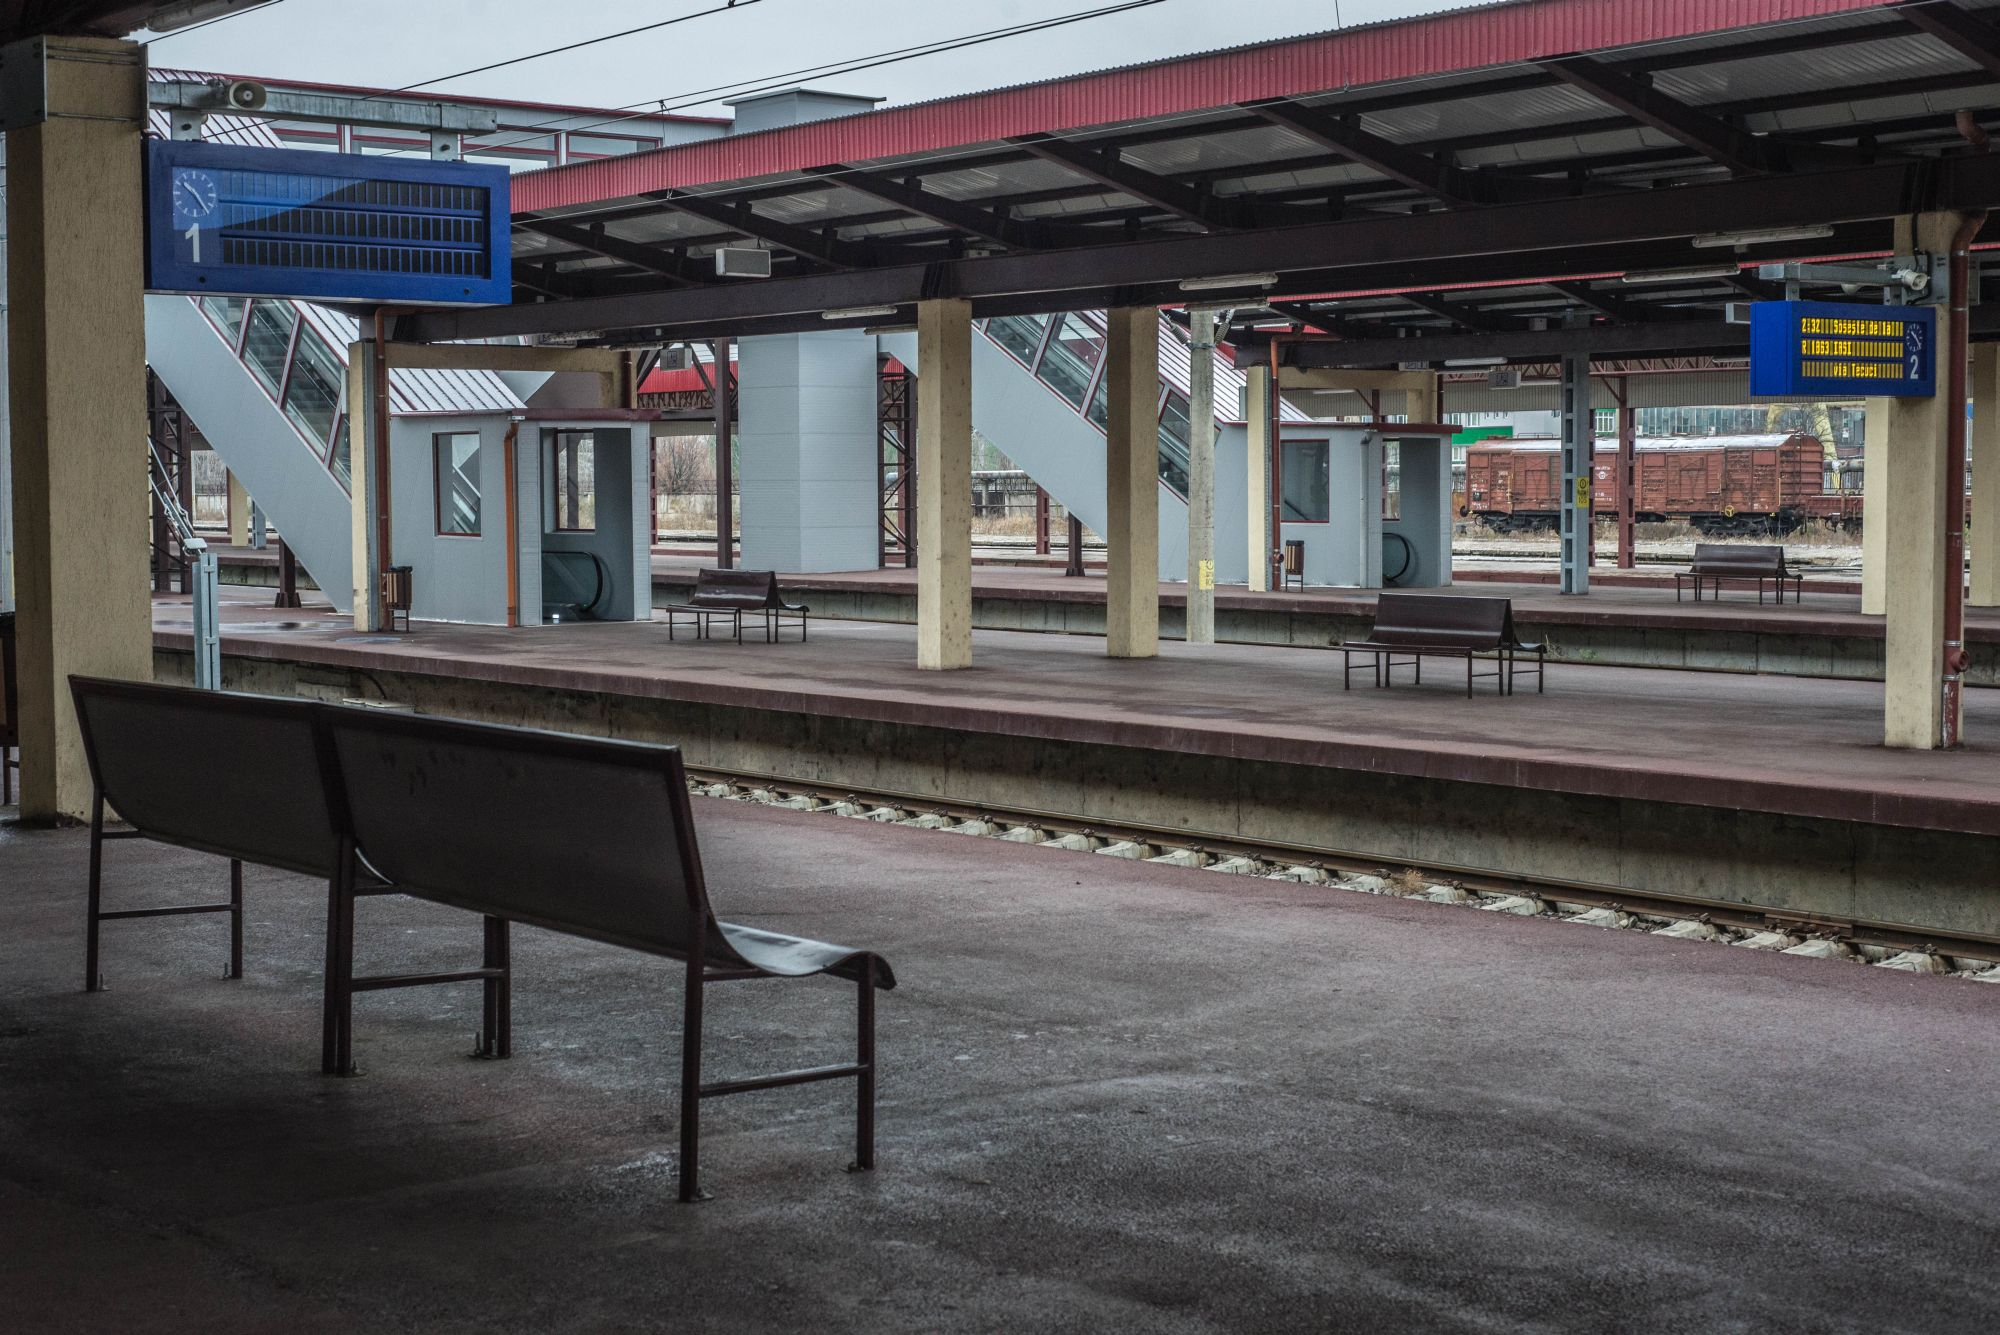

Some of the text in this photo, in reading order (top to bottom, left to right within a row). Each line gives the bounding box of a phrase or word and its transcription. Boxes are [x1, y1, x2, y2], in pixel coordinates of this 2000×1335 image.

[185, 222, 200, 262] 1
[1869, 320, 1878, 335] de
[1883, 321, 1891, 336] la
[1802, 340, 1807, 355] R
[1834, 363, 1877, 377] via Tecuci
[1910, 354, 1919, 379] 2
